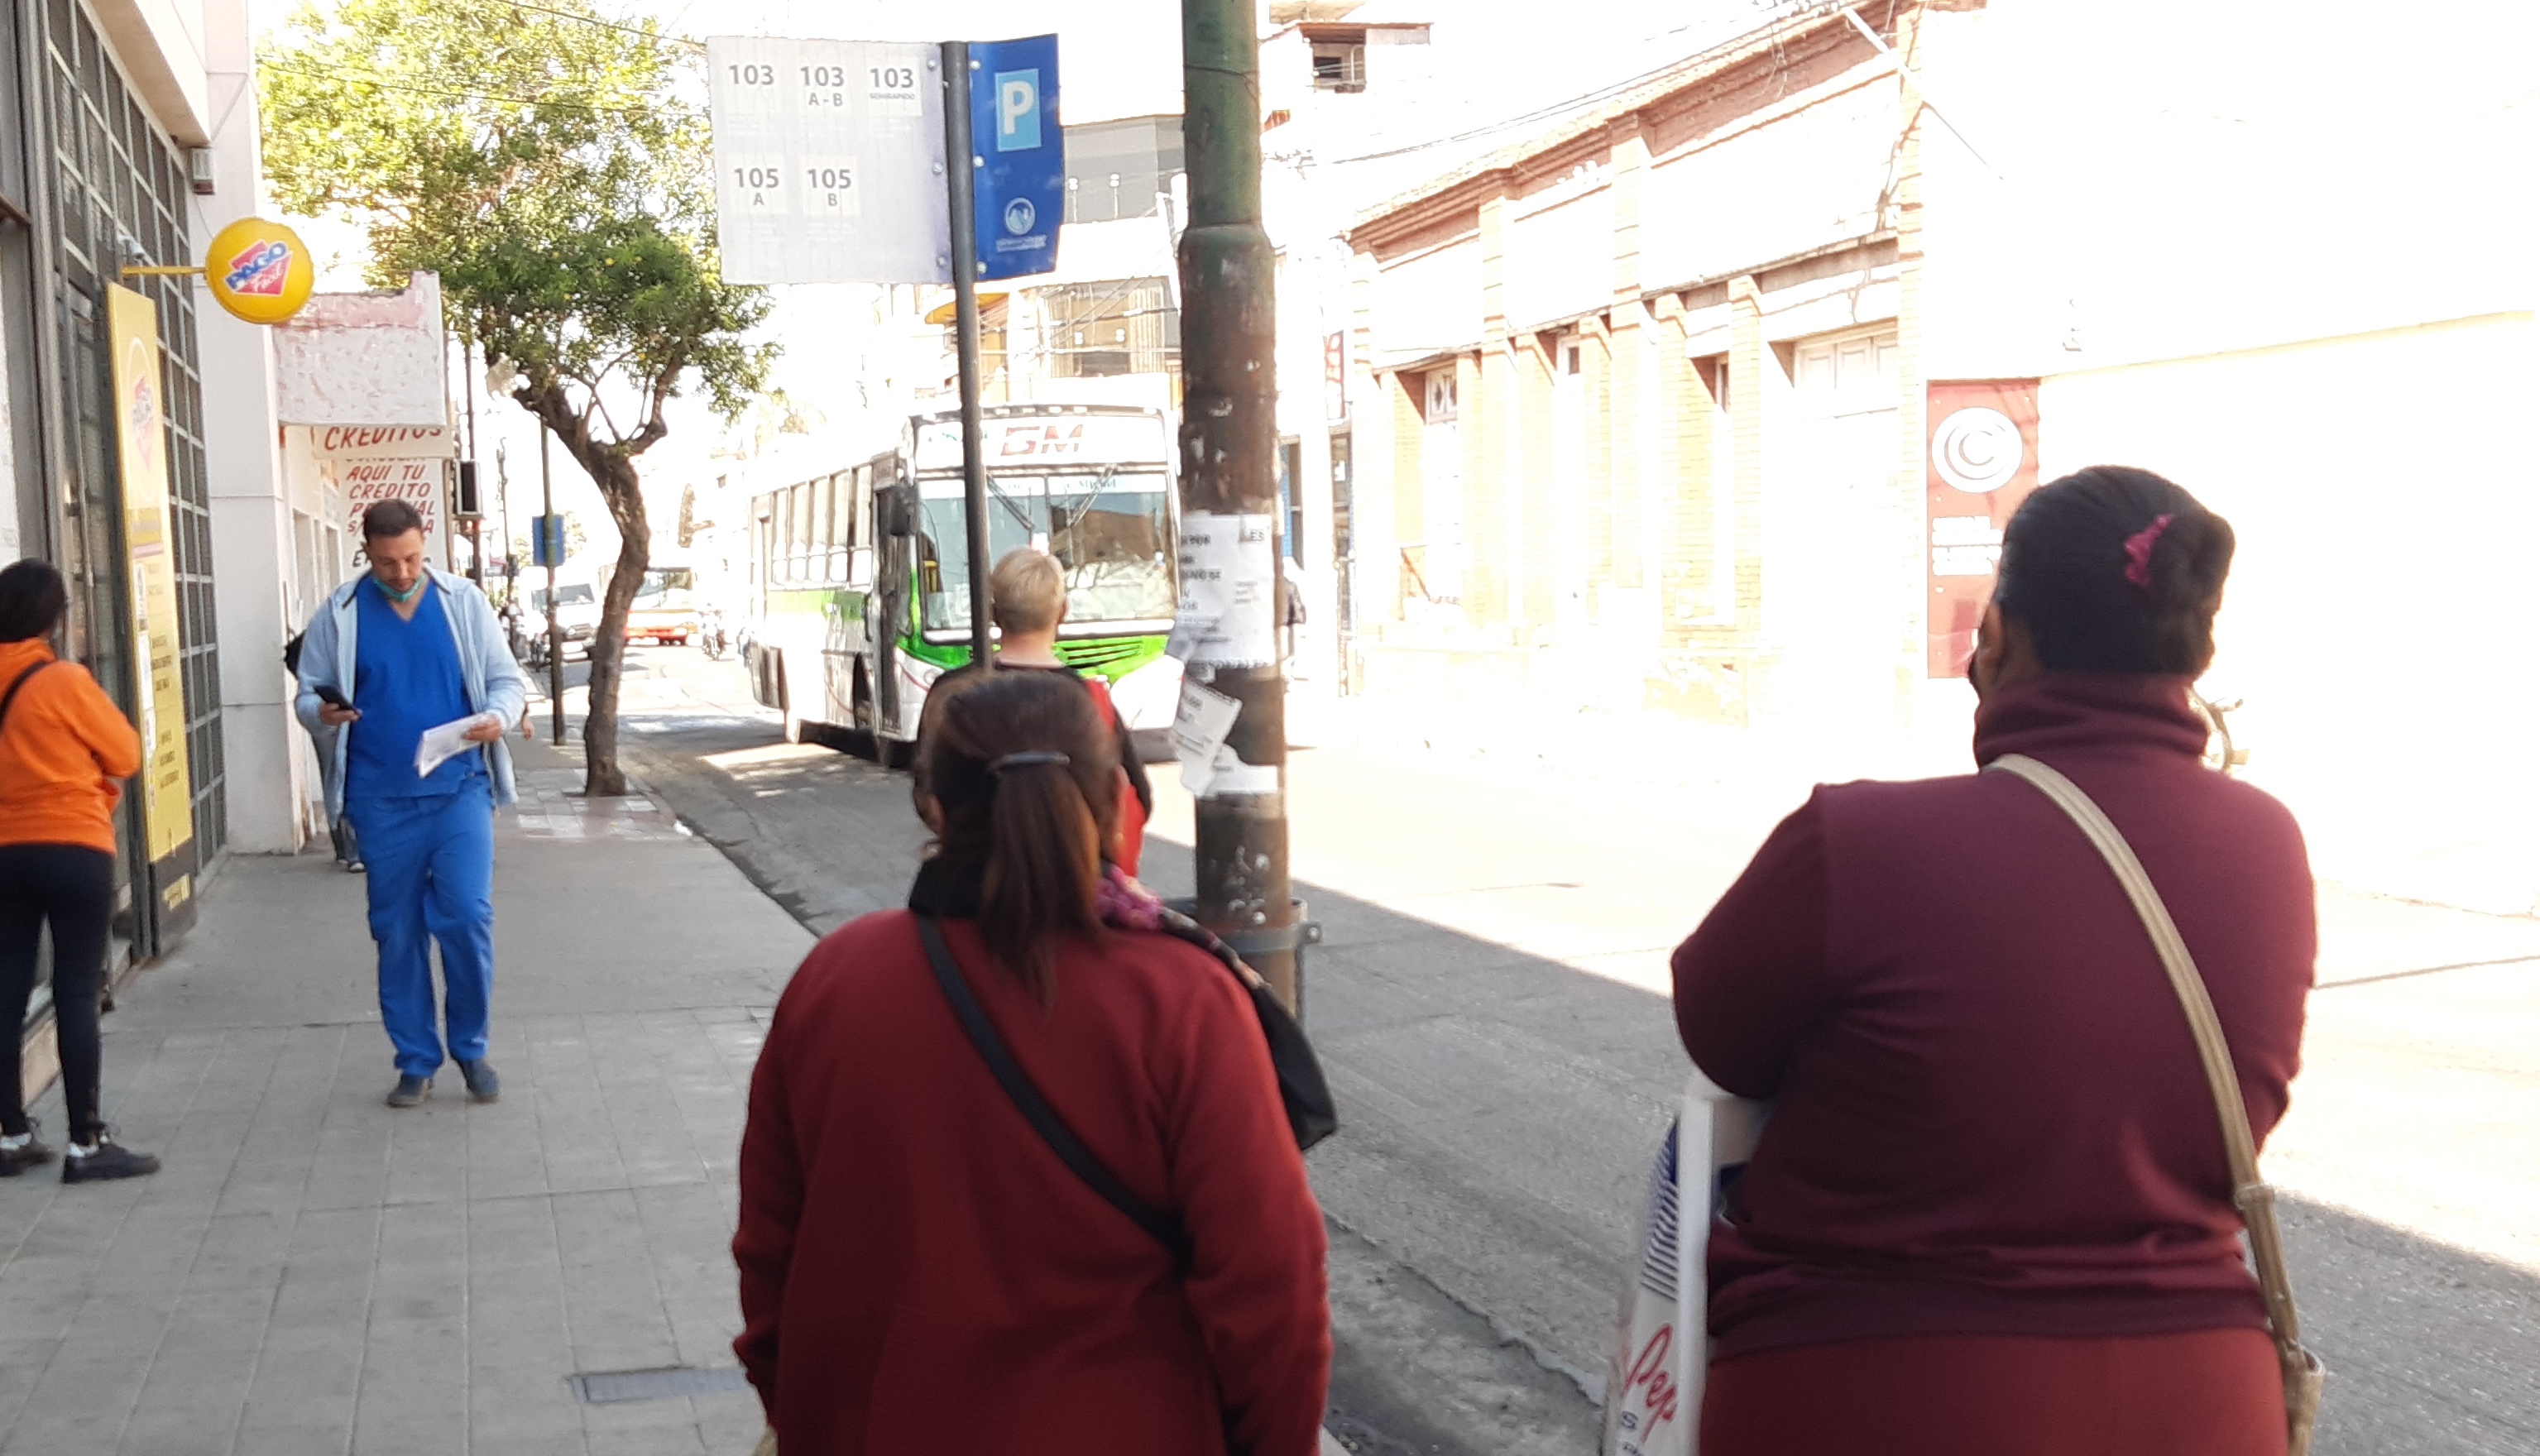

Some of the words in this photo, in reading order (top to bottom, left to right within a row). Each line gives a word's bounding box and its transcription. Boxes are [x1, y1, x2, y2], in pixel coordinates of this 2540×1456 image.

[728, 65, 774, 85] 103
[800, 66, 845, 87] 103
[869, 67, 914, 89] 103
[1002, 80, 1034, 135] P
[734, 167, 779, 189] 105
[807, 169, 852, 189] 105
[753, 193, 764, 206] A
[827, 193, 838, 207] B
[225, 242, 288, 290] PAGO
[1000, 424, 1084, 457] GM
[346, 465, 392, 481] AQUI
[403, 464, 426, 481] TU
[349, 481, 432, 500] CREDITO
